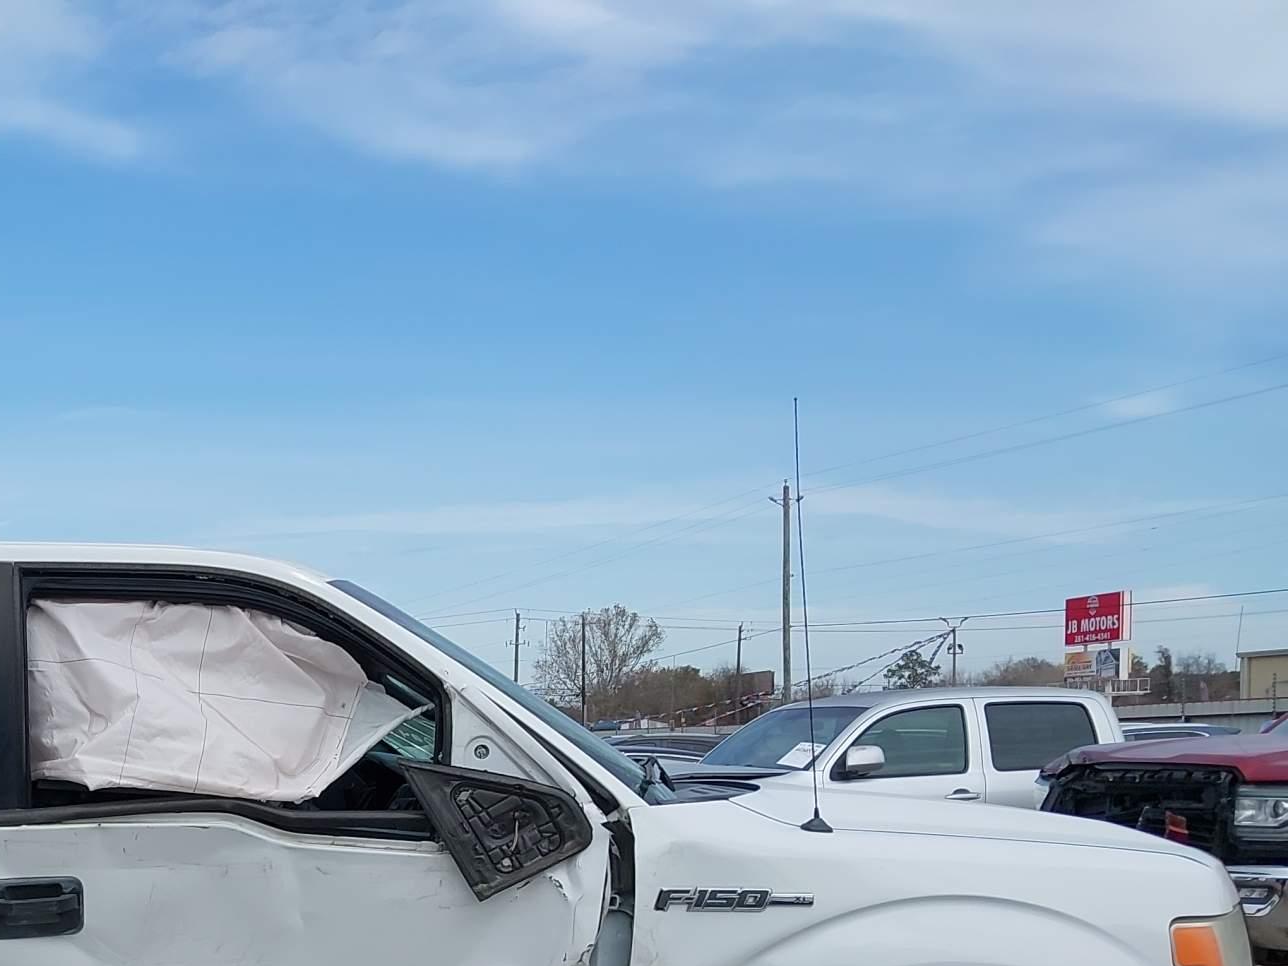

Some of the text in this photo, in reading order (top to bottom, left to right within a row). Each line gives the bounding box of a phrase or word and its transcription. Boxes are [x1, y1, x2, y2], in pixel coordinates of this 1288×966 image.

[1067, 615, 1119, 634] JB MOTORS
[653, 887, 772, 913] F-150
